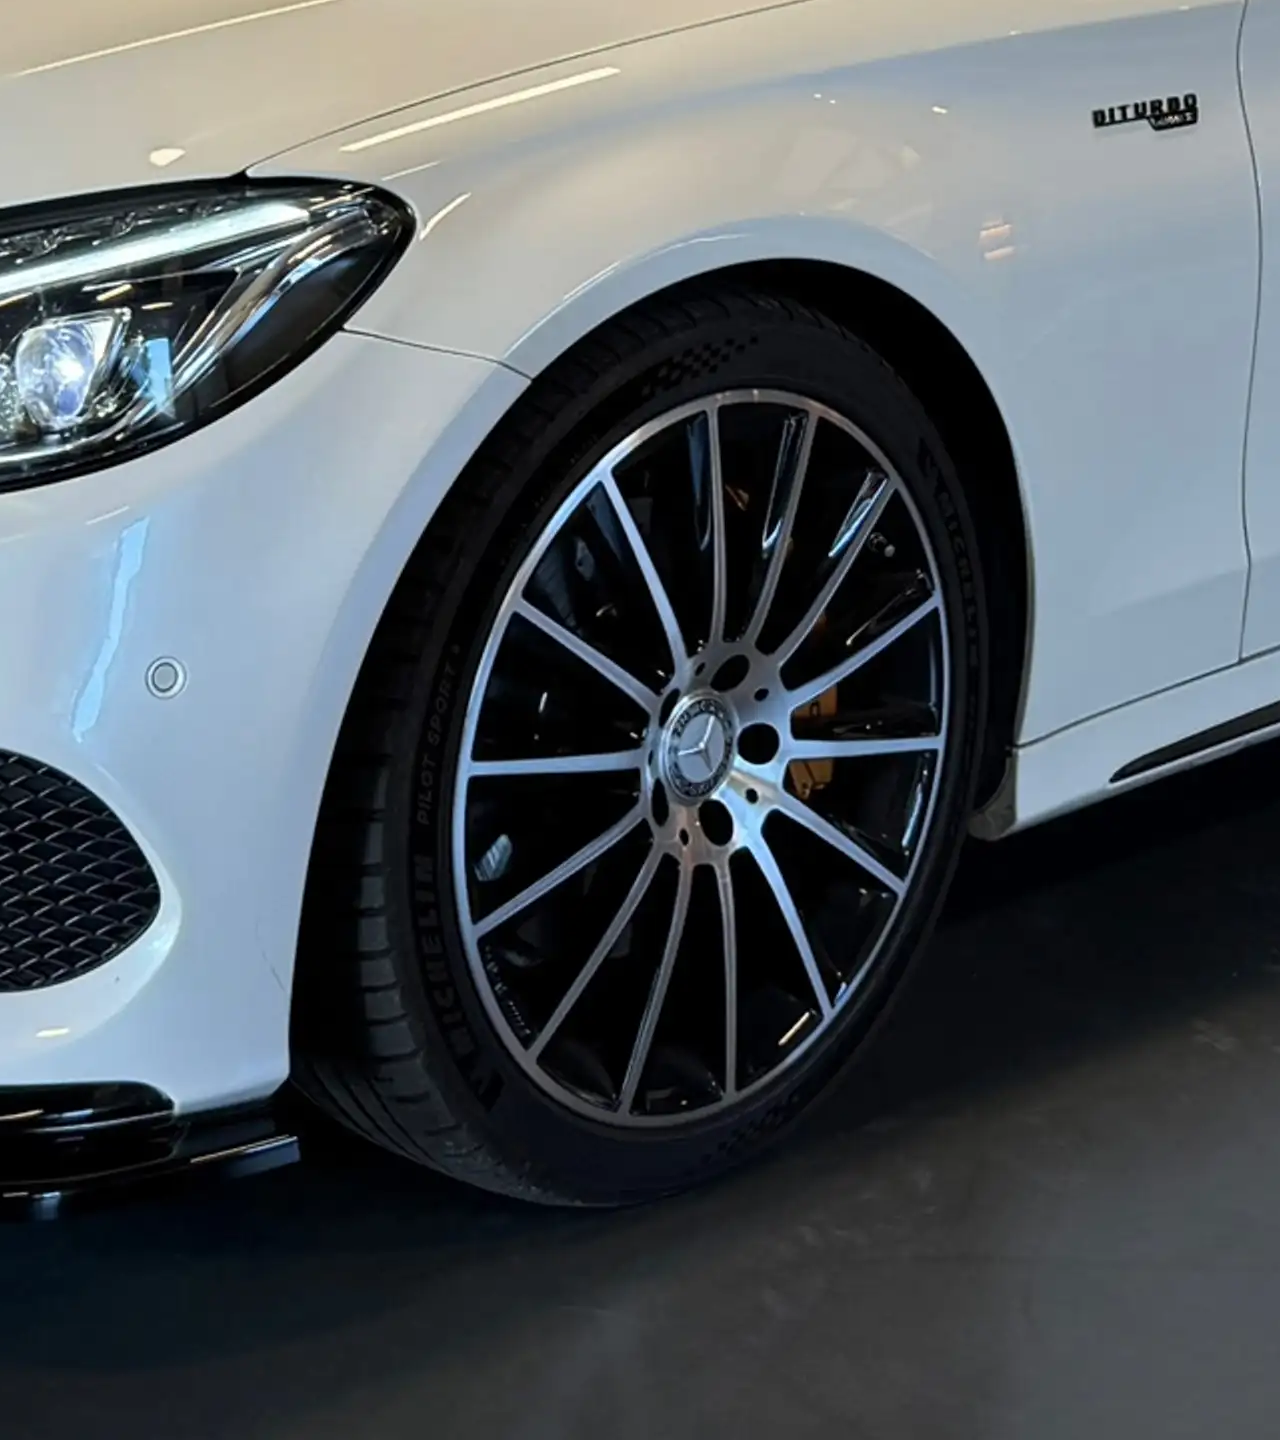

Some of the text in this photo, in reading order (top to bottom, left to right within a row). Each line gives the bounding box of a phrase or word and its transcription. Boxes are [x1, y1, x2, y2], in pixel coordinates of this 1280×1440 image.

[1091, 93, 1198, 129] BITURBO
[427, 660, 458, 748] SPORT
[416, 753, 437, 826] PILOT
[414, 853, 475, 1058] MICHELIN
